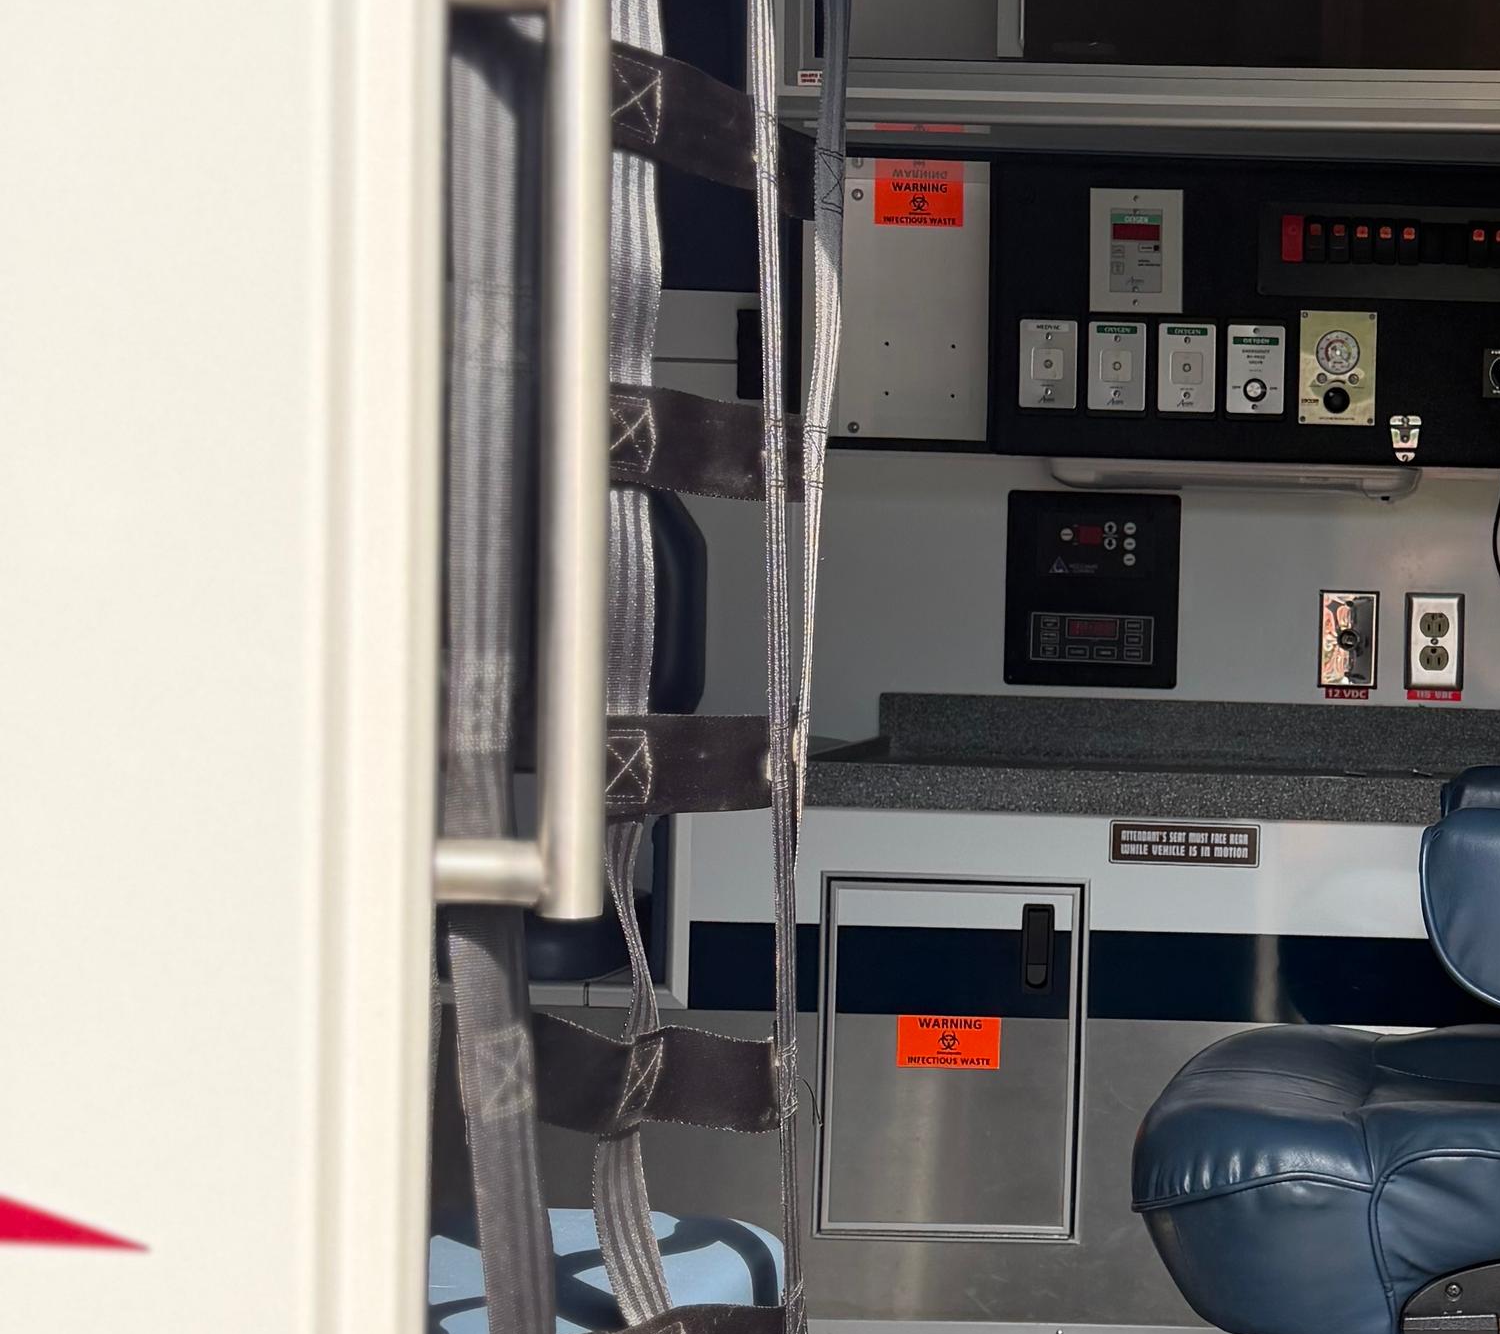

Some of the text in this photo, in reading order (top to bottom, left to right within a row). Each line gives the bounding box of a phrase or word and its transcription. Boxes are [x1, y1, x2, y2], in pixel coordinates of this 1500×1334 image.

[892, 182, 948, 193] WARNING
[883, 216, 956, 225] INFECTIOUS WASTE
[1327, 689, 1367, 699] 12 VDC
[1121, 830, 1249, 845] ATTENDANT'S SEAT MUST FACE REAR
[1120, 844, 1149, 855] WHILE
[1151, 845, 1186, 856] VEHICLE
[1189, 846, 1198, 857] IS
[1214, 846, 1249, 858] MOTION
[918, 1018, 982, 1030] WARNING
[907, 1056, 990, 1066] INFECTIOUS WASTE
